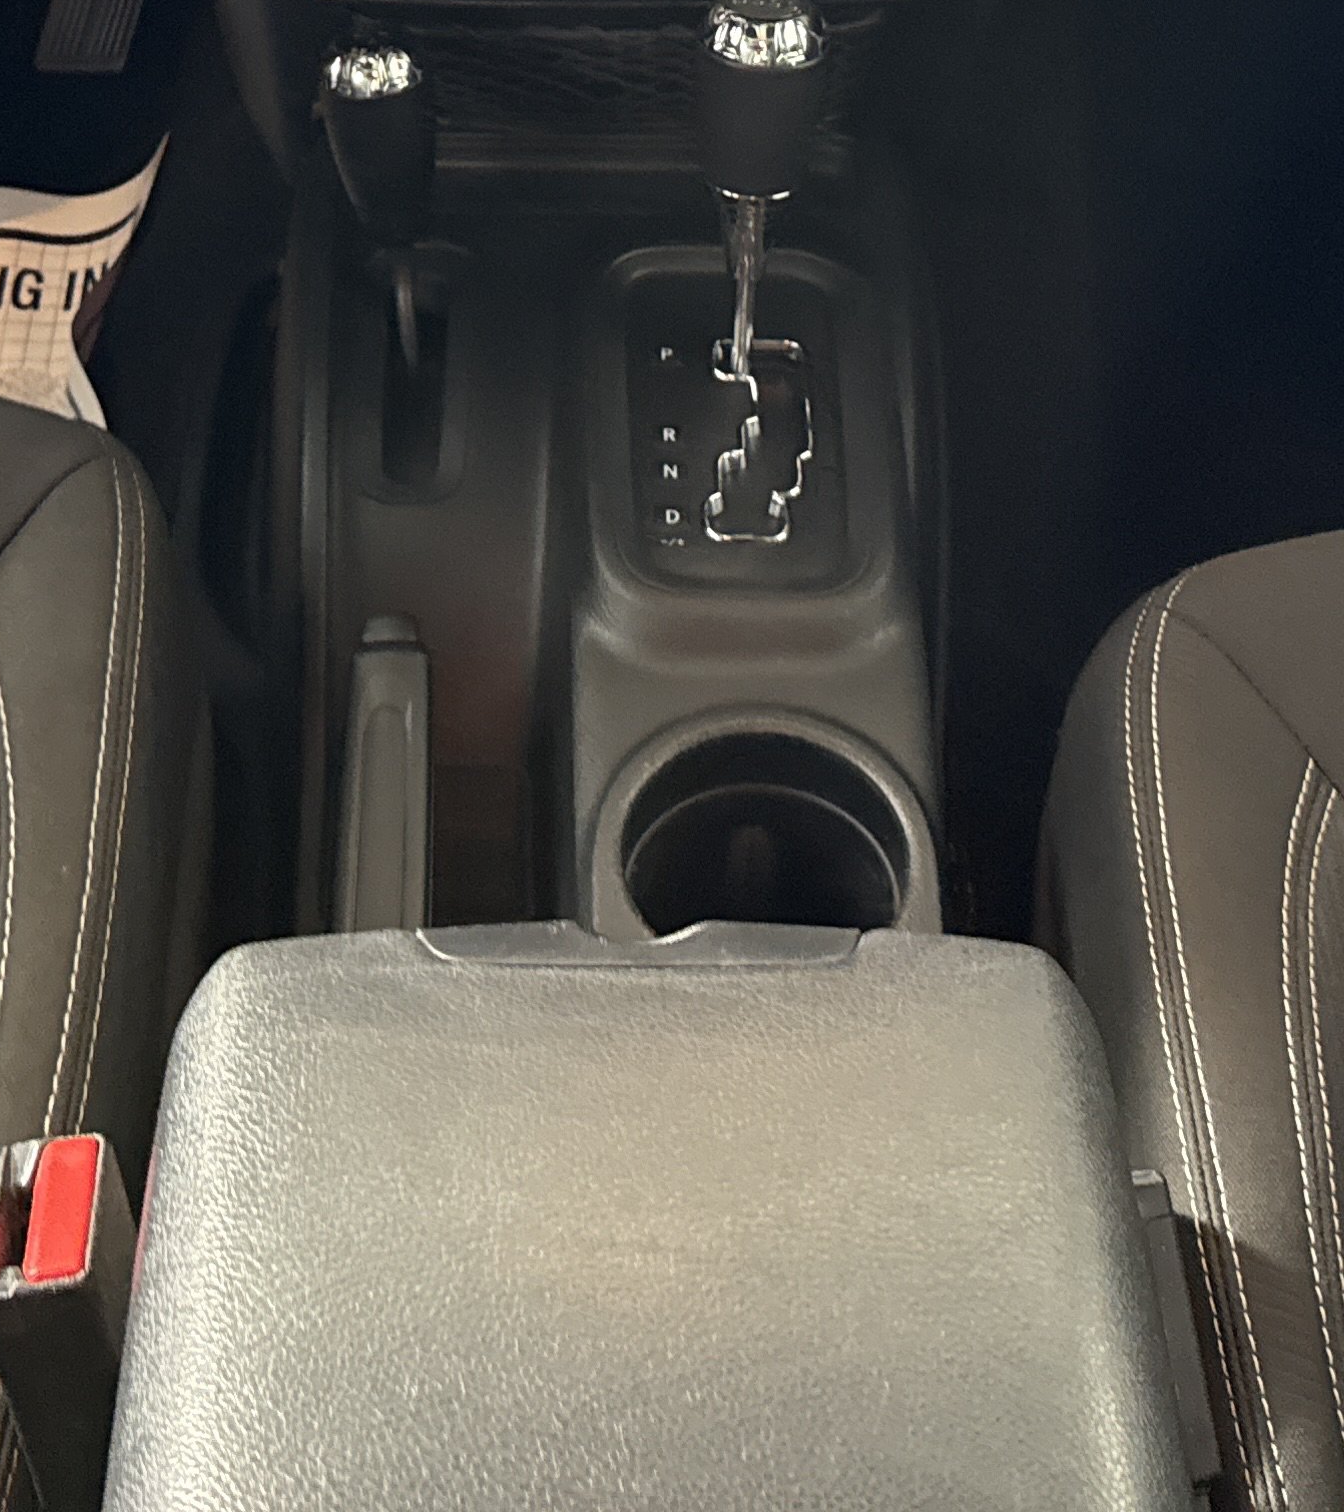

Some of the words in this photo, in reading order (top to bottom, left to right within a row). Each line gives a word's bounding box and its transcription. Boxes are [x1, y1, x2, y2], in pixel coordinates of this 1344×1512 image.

[660, 347, 674, 361] P
[662, 427, 676, 442] R
[663, 464, 678, 479] N
[665, 509, 680, 524] D
